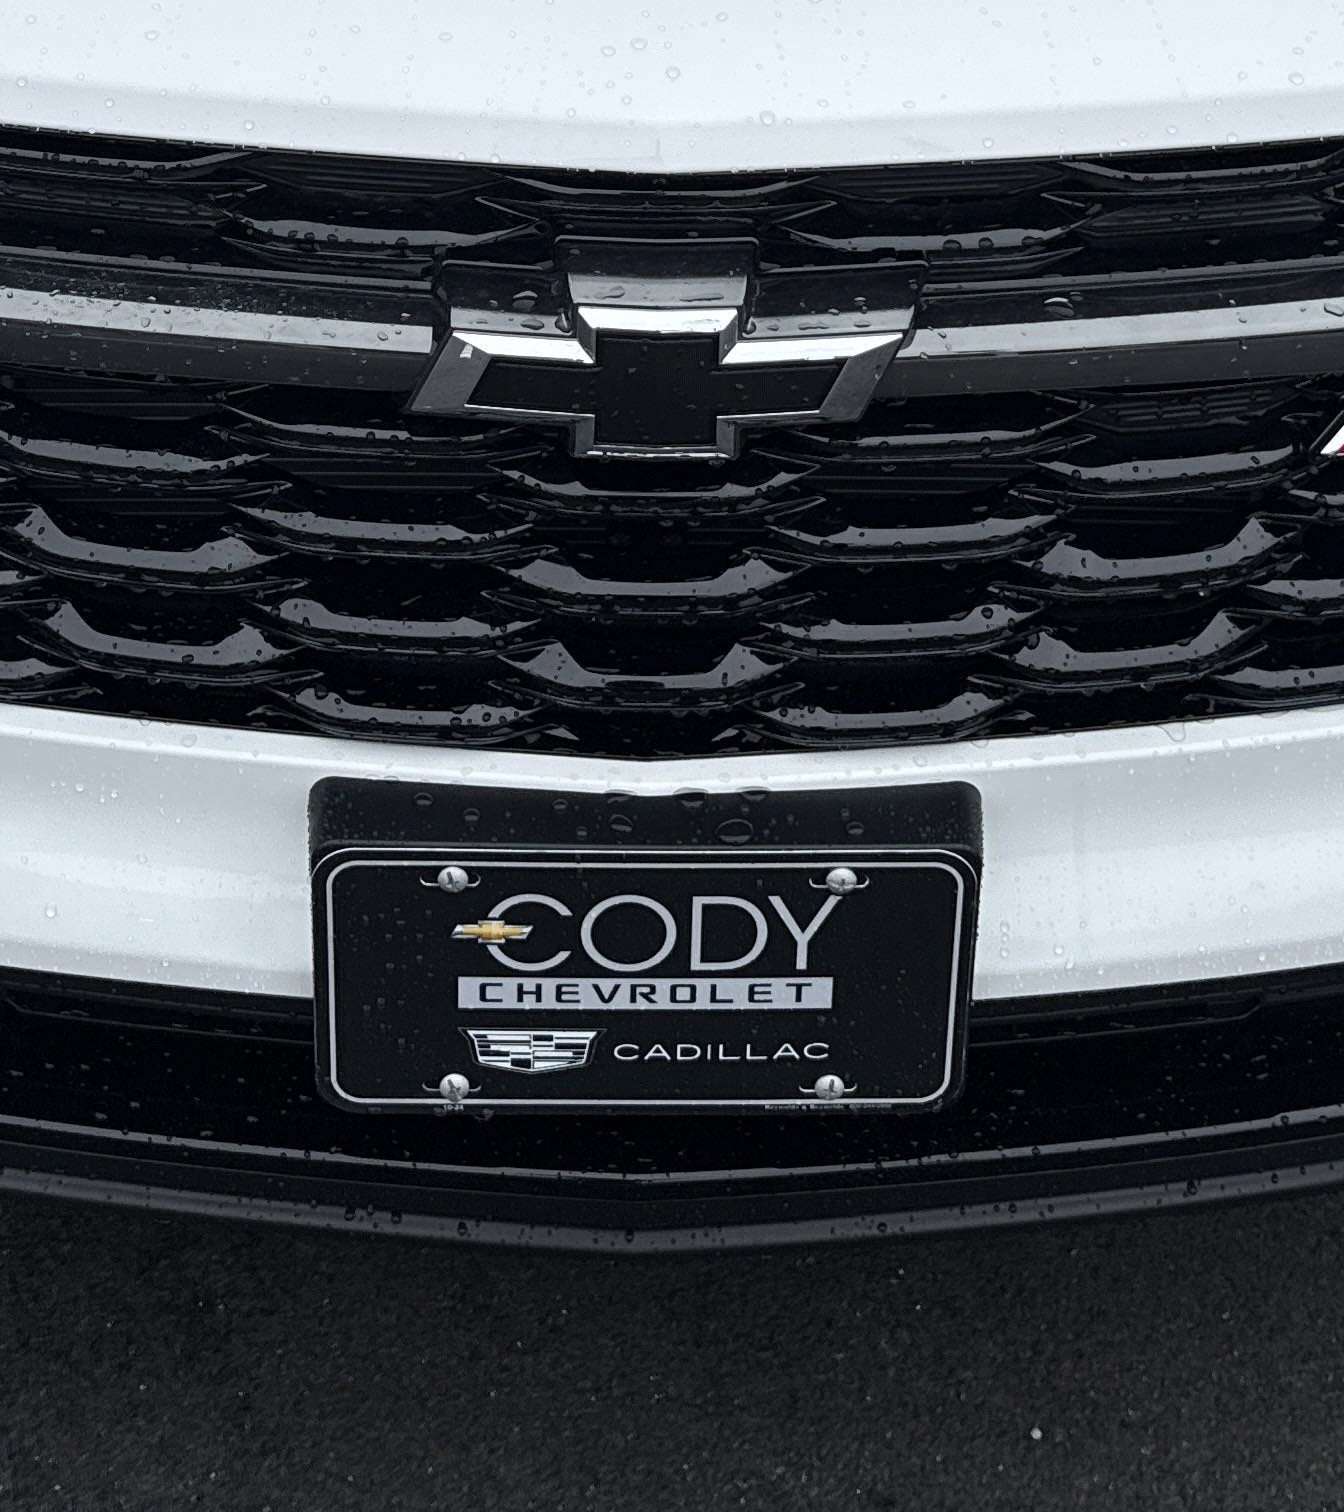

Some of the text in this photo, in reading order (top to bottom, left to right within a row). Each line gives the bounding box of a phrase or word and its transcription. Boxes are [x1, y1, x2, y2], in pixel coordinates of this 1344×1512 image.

[485, 893, 842, 972] CODY
[478, 982, 813, 1005] CHEVROLET
[613, 1042, 830, 1061] CADILLAC
